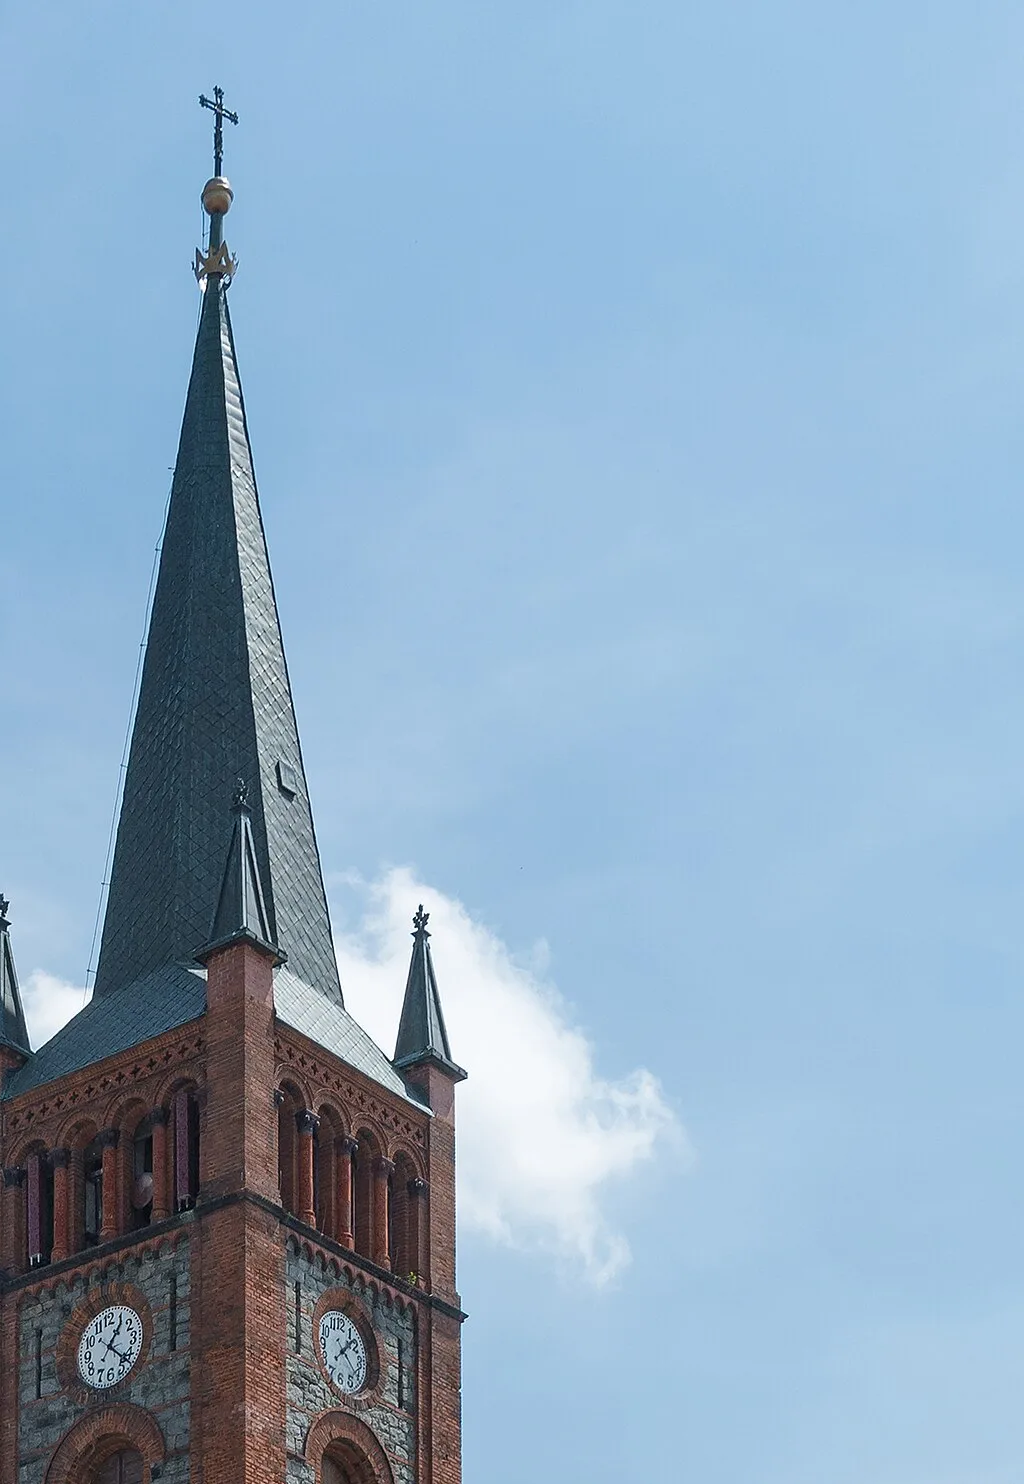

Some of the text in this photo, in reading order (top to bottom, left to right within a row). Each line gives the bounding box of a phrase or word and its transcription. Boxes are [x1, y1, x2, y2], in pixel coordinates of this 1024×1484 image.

[104, 1312, 115, 1328] 12
[126, 1318, 134, 1332] 2
[330, 1316, 336, 1330] 11
[336, 1317, 345, 1333] 12
[95, 1320, 102, 1335] 11
[322, 1324, 330, 1338] 10
[348, 1328, 352, 1340] 1
[86, 1335, 96, 1350] 10
[130, 1330, 137, 1345] 3
[320, 1336, 326, 1350] 9
[124, 1346, 134, 1360] 4
[351, 1338, 358, 1354] 2
[84, 1351, 92, 1364] 9
[88, 1362, 94, 1376] 8
[118, 1360, 126, 1375] 5
[328, 1364, 336, 1378] 7
[97, 1368, 104, 1382] 7
[106, 1368, 114, 1382] 6
[338, 1372, 344, 1384] 6
[347, 1374, 354, 1388] 5
